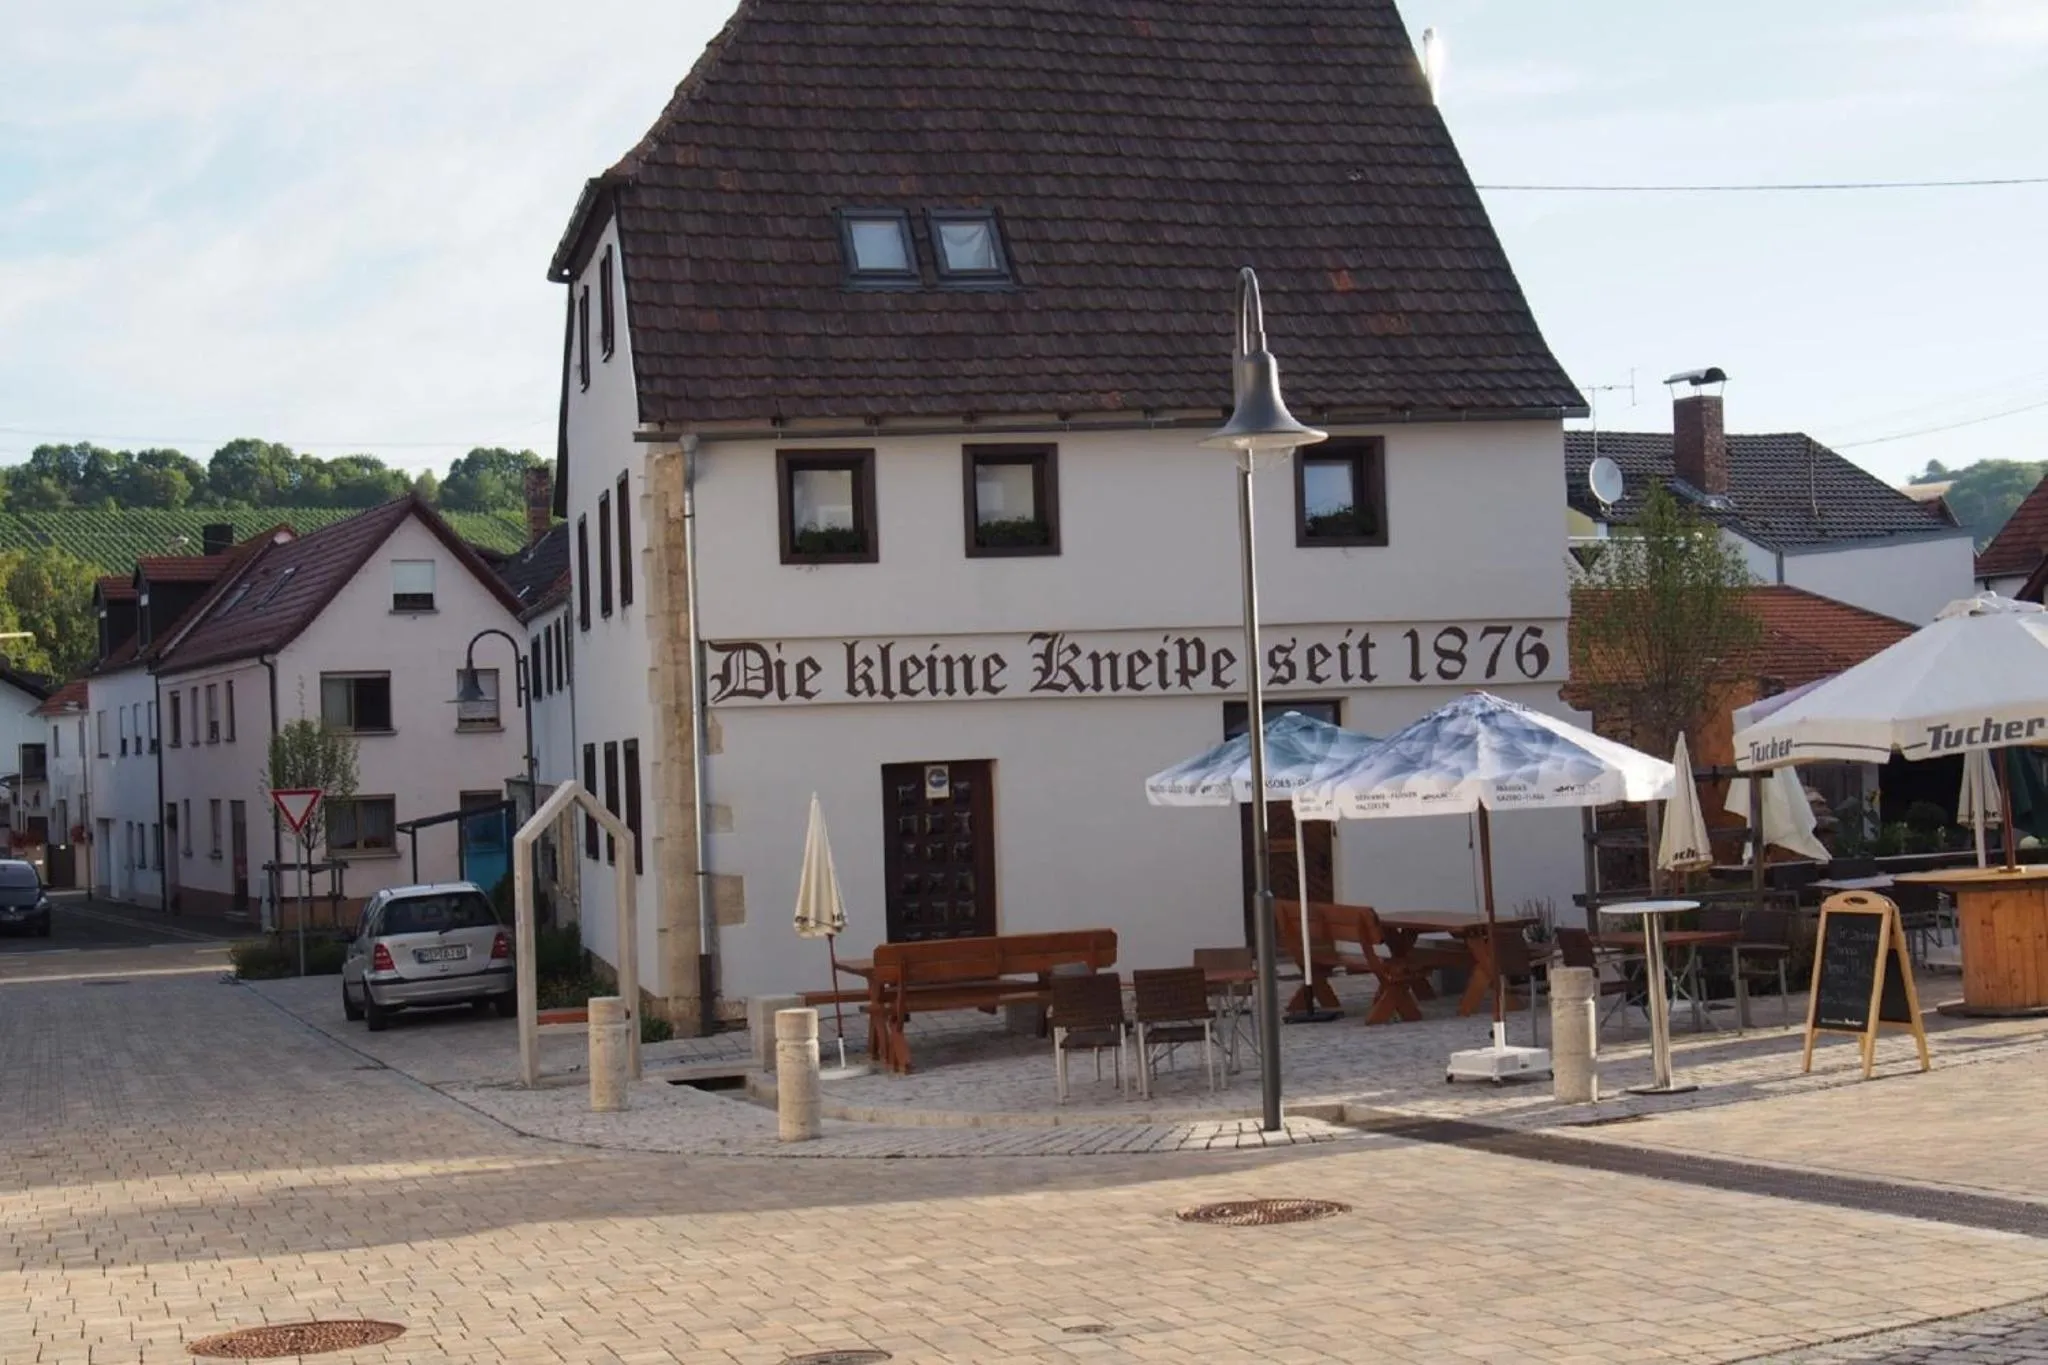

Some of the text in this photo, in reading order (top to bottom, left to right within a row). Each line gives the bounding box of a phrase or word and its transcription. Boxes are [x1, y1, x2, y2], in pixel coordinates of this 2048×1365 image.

[708, 625, 1551, 704] Die kleine Kneipe seit 1876
[1749, 736, 1793, 763] Tucher
[1928, 717, 2046, 751] Tucher
